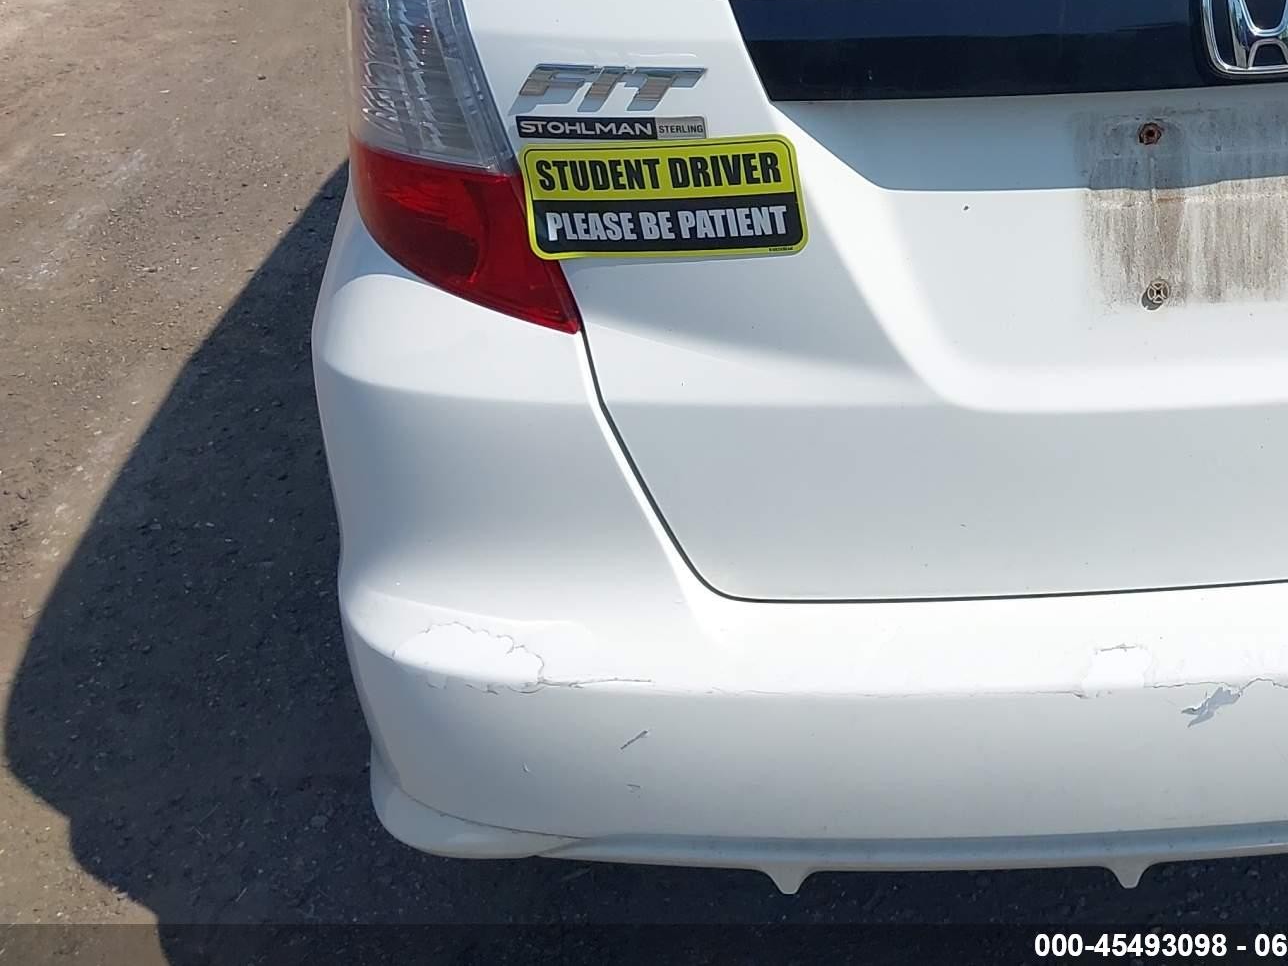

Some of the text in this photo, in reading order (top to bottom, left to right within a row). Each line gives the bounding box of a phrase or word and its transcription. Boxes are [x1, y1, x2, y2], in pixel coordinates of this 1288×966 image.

[508, 63, 707, 115] FIT
[520, 121, 704, 135] STOHLMAN STERLING
[536, 152, 782, 192] STUDENT DRIVER
[547, 205, 787, 241] PLEASE BE PATIENT
